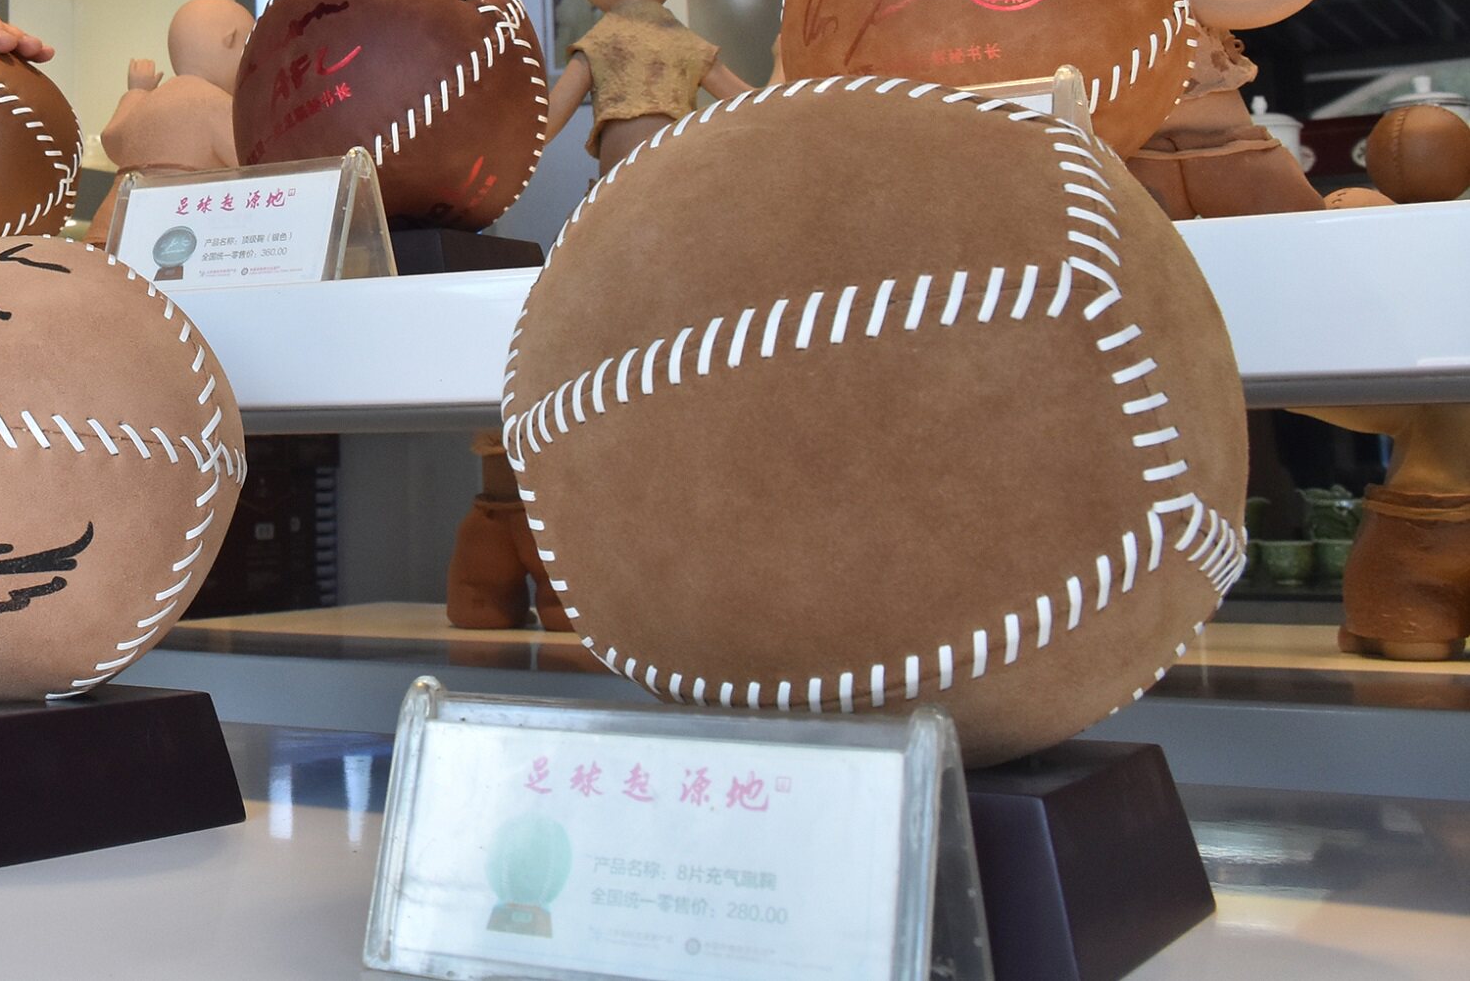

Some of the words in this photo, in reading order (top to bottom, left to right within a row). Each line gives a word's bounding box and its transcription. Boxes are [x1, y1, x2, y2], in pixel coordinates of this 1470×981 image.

[175, 188, 285, 216] 足球起源地
[523, 756, 771, 813] 足球起源地
